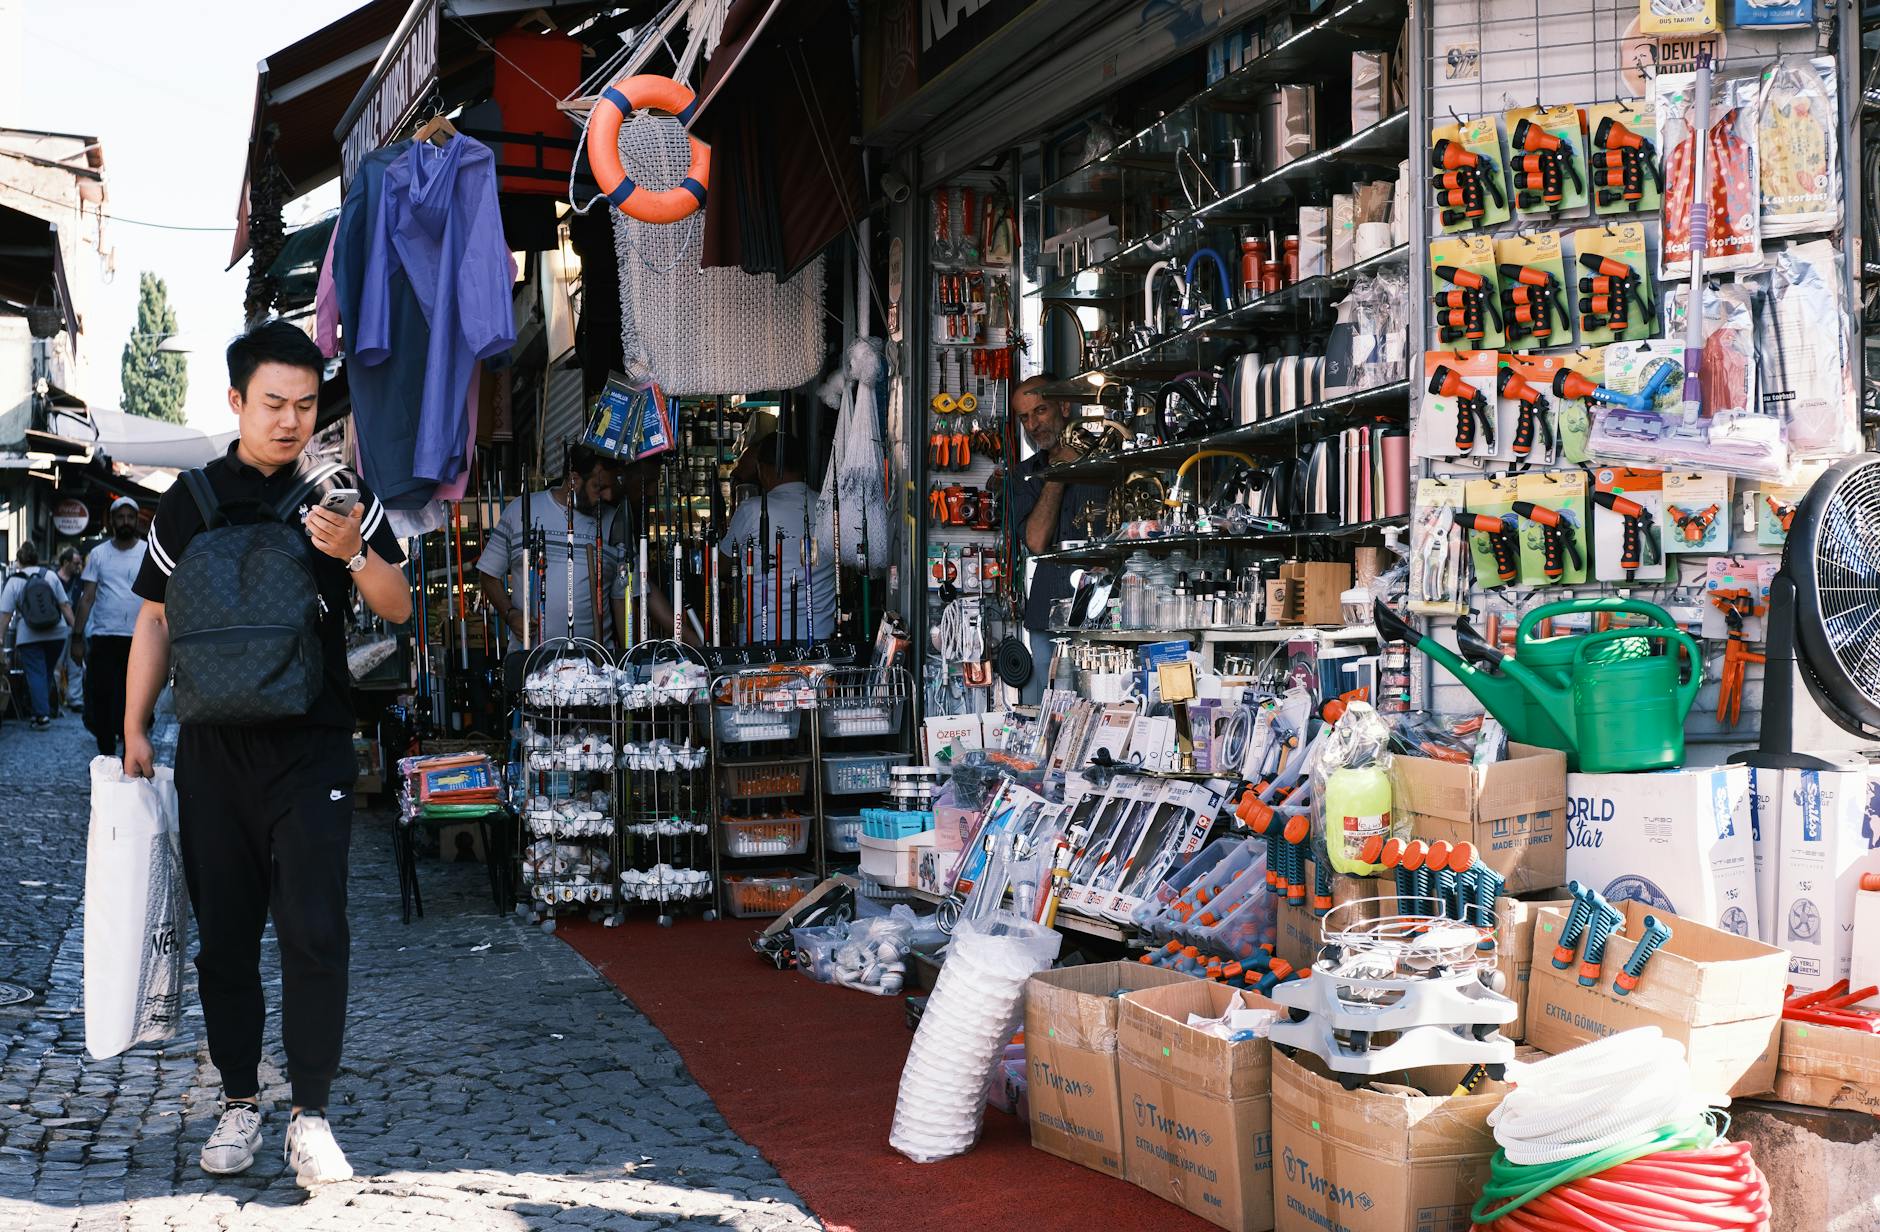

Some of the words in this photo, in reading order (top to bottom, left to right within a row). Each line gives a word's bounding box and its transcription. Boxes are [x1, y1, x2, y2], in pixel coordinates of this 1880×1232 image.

[1662, 40, 1716, 61] DEVLET
[381, 47, 410, 140] MURAT
[937, 729, 972, 740] ÖZBEST
[1566, 797, 1615, 821] ORLD
[1492, 840, 1513, 850] MADE
[1514, 839, 1522, 848] IN
[1524, 834, 1553, 846] TURKEY
[1566, 816, 1604, 849] Star
[1545, 1003, 1573, 1023] EXTRA
[1574, 1012, 1607, 1038] GÖMME
[1041, 1062, 1082, 1097] Turan
[1039, 1111, 1054, 1126] EXTRA
[1146, 1103, 1198, 1145] Turan
[1135, 1136, 1155, 1155] EXTRA
[1156, 1145, 1180, 1167] GÖMME
[1180, 1158, 1196, 1175] KAPI
[1296, 1158, 1354, 1209] Turan
[1287, 1194, 1308, 1219] EXTRA
[1308, 1207, 1333, 1231] GÖMME
